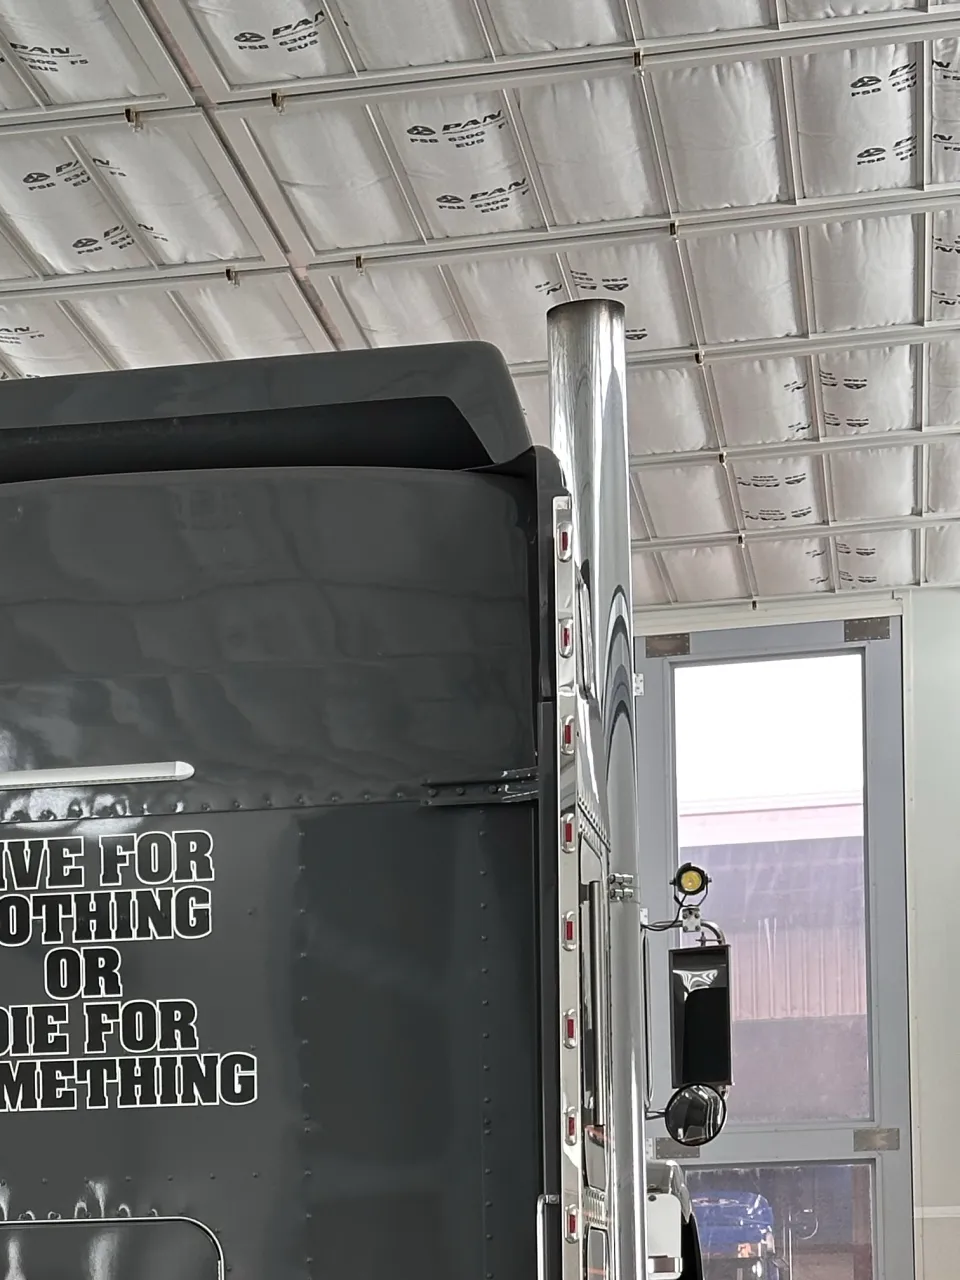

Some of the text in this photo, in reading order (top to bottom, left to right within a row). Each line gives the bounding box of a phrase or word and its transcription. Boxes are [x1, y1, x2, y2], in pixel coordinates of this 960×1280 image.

[441, 109, 503, 132] PAN
[447, 130, 486, 143] 630G
[469, 177, 527, 201] PAN
[99, 829, 215, 887] FOR
[44, 946, 123, 1000] OR
[83, 998, 199, 1054] FOR
